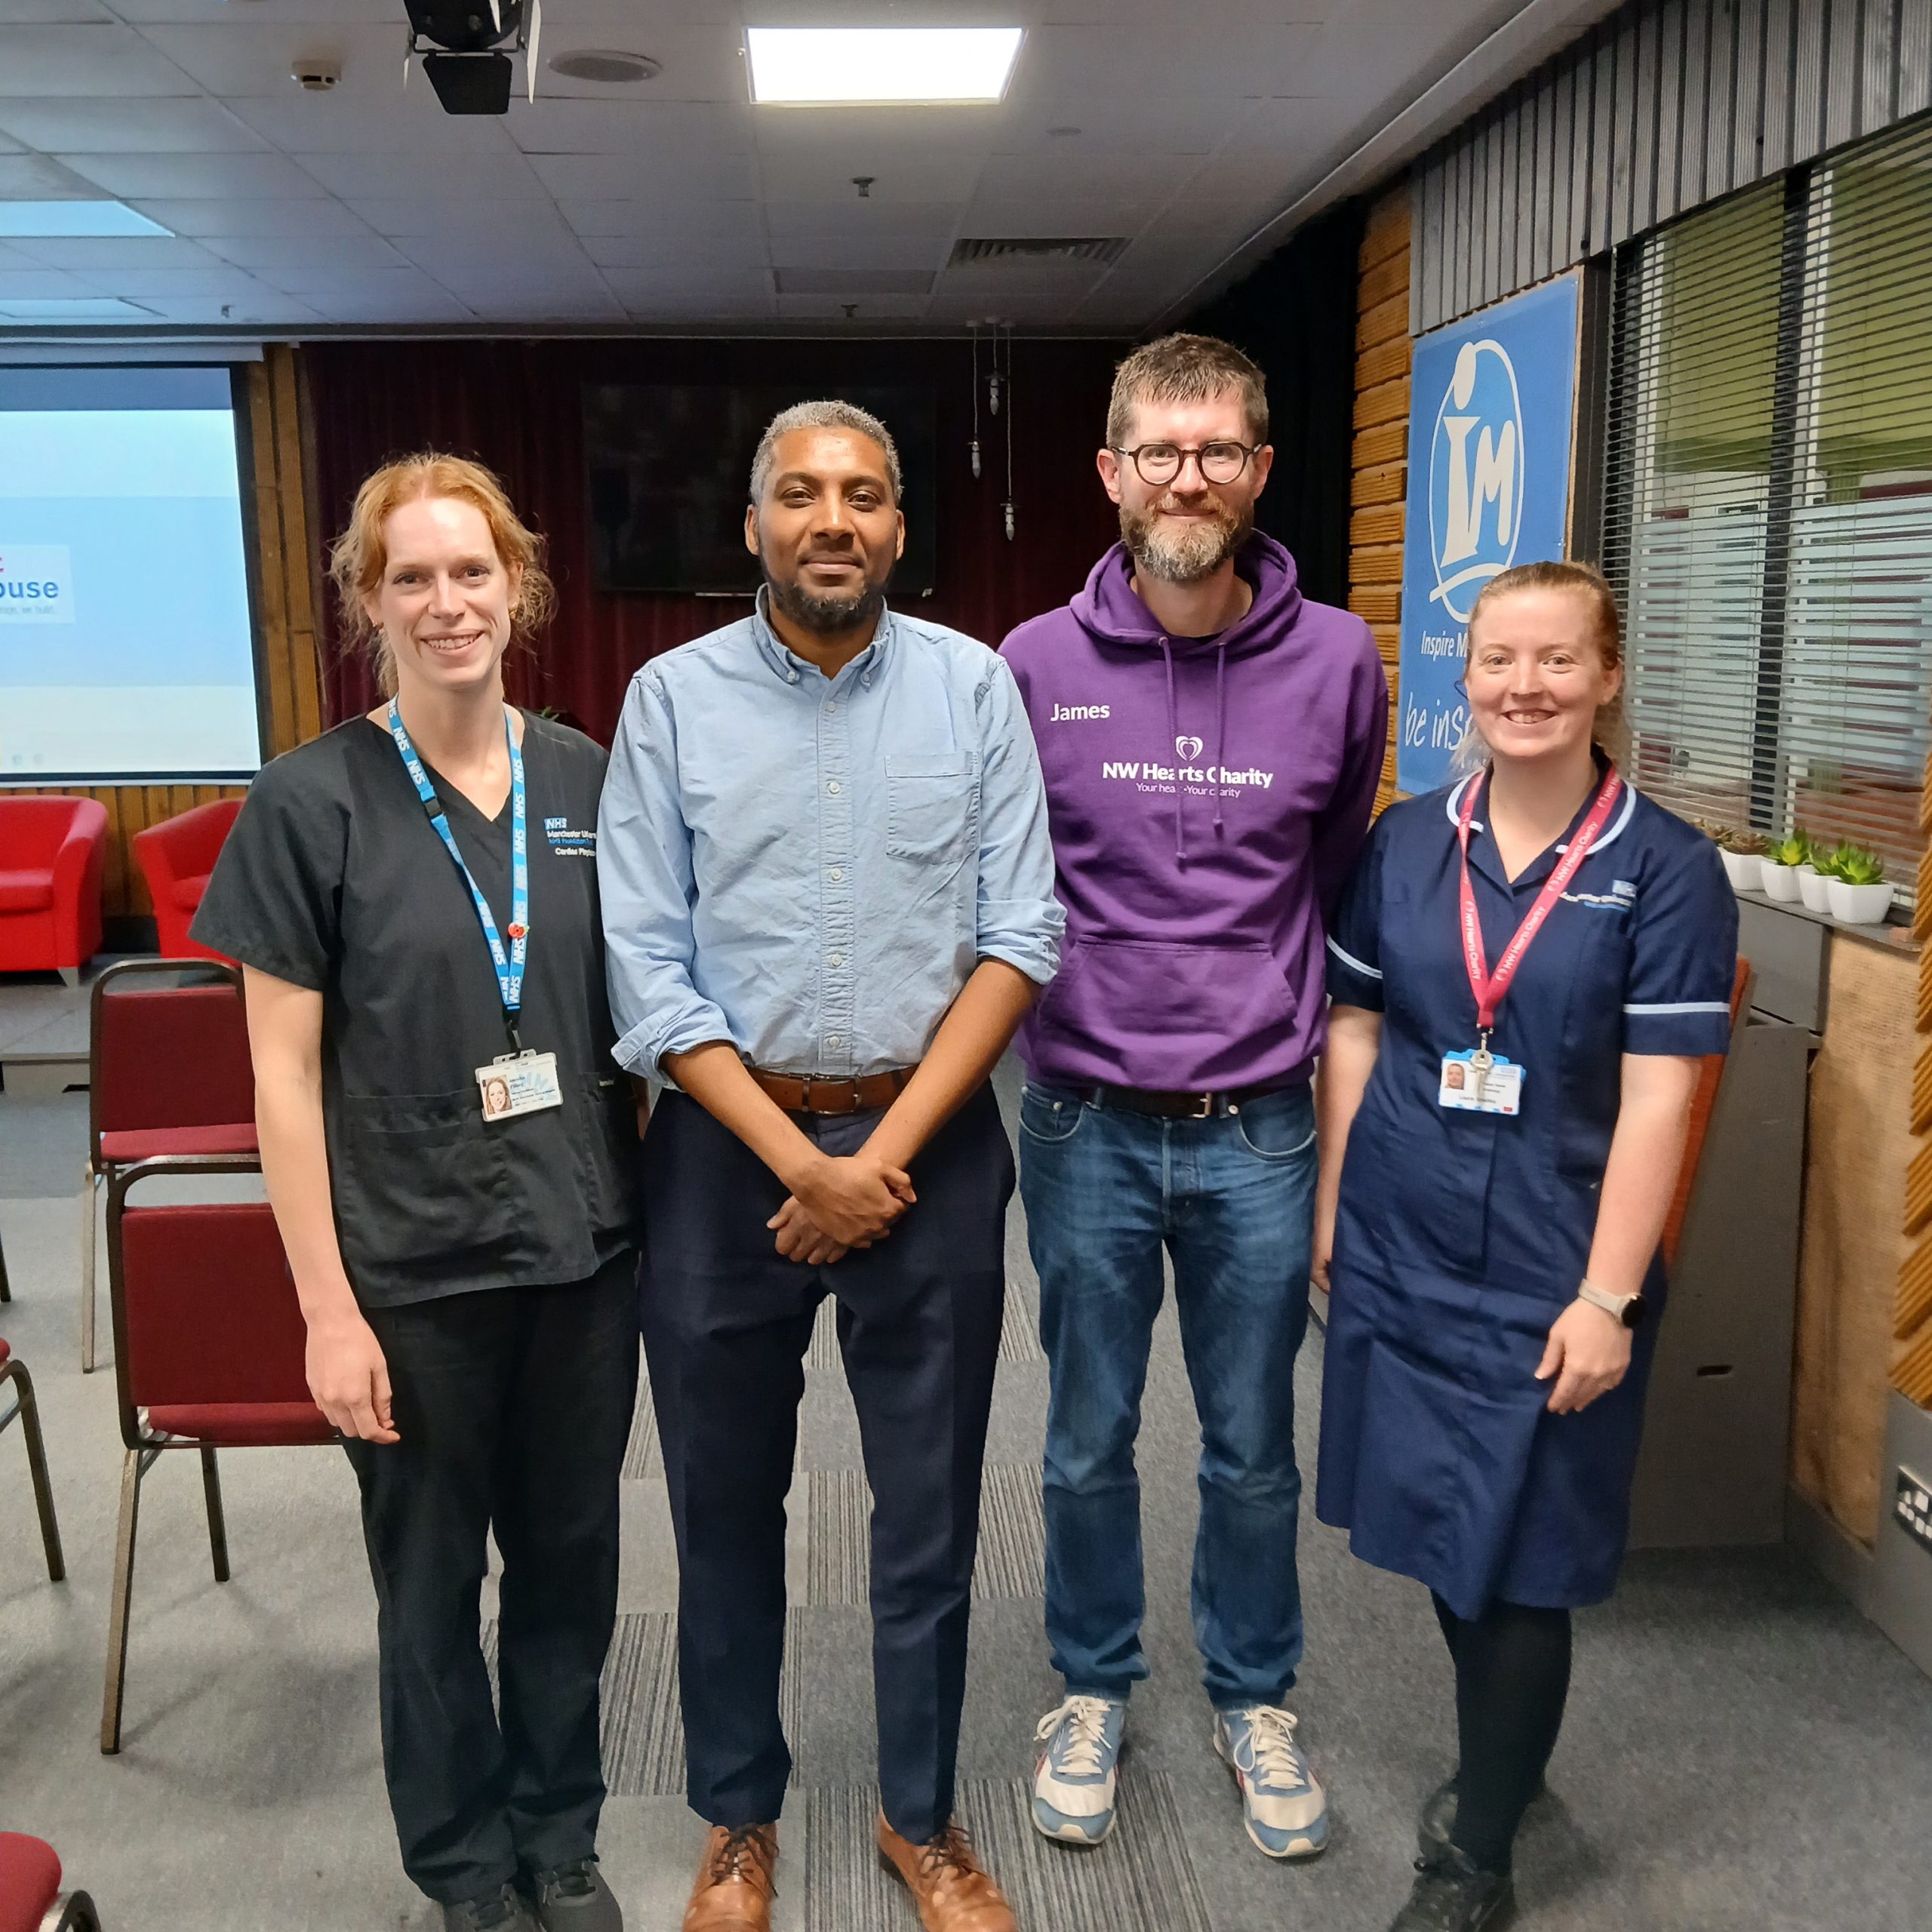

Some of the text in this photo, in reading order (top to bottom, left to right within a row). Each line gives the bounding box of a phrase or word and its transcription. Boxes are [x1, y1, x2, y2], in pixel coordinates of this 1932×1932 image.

[1421, 631, 1454, 662] Inspire
[1050, 703, 1111, 722] James
[1405, 691, 1427, 747] be
[393, 728, 410, 752] NHS
[407, 759, 426, 785] NHS
[513, 757, 523, 783] NHS
[1102, 762, 1273, 788] NW Hearts Charity
[1136, 782, 1158, 793] Your
[1158, 783, 1182, 795] hea
[1209, 787, 1241, 798] carity
[514, 792, 525, 820] NHS
[545, 817, 568, 829] NHS
[515, 828, 525, 855] NHS
[1555, 821, 1599, 881] NW Hearts Charity
[1503, 905, 1546, 970] NW Hearts Charity
[491, 939, 505, 966] NHS
[513, 938, 525, 965] NHS
[509, 975, 521, 1003] NHS
